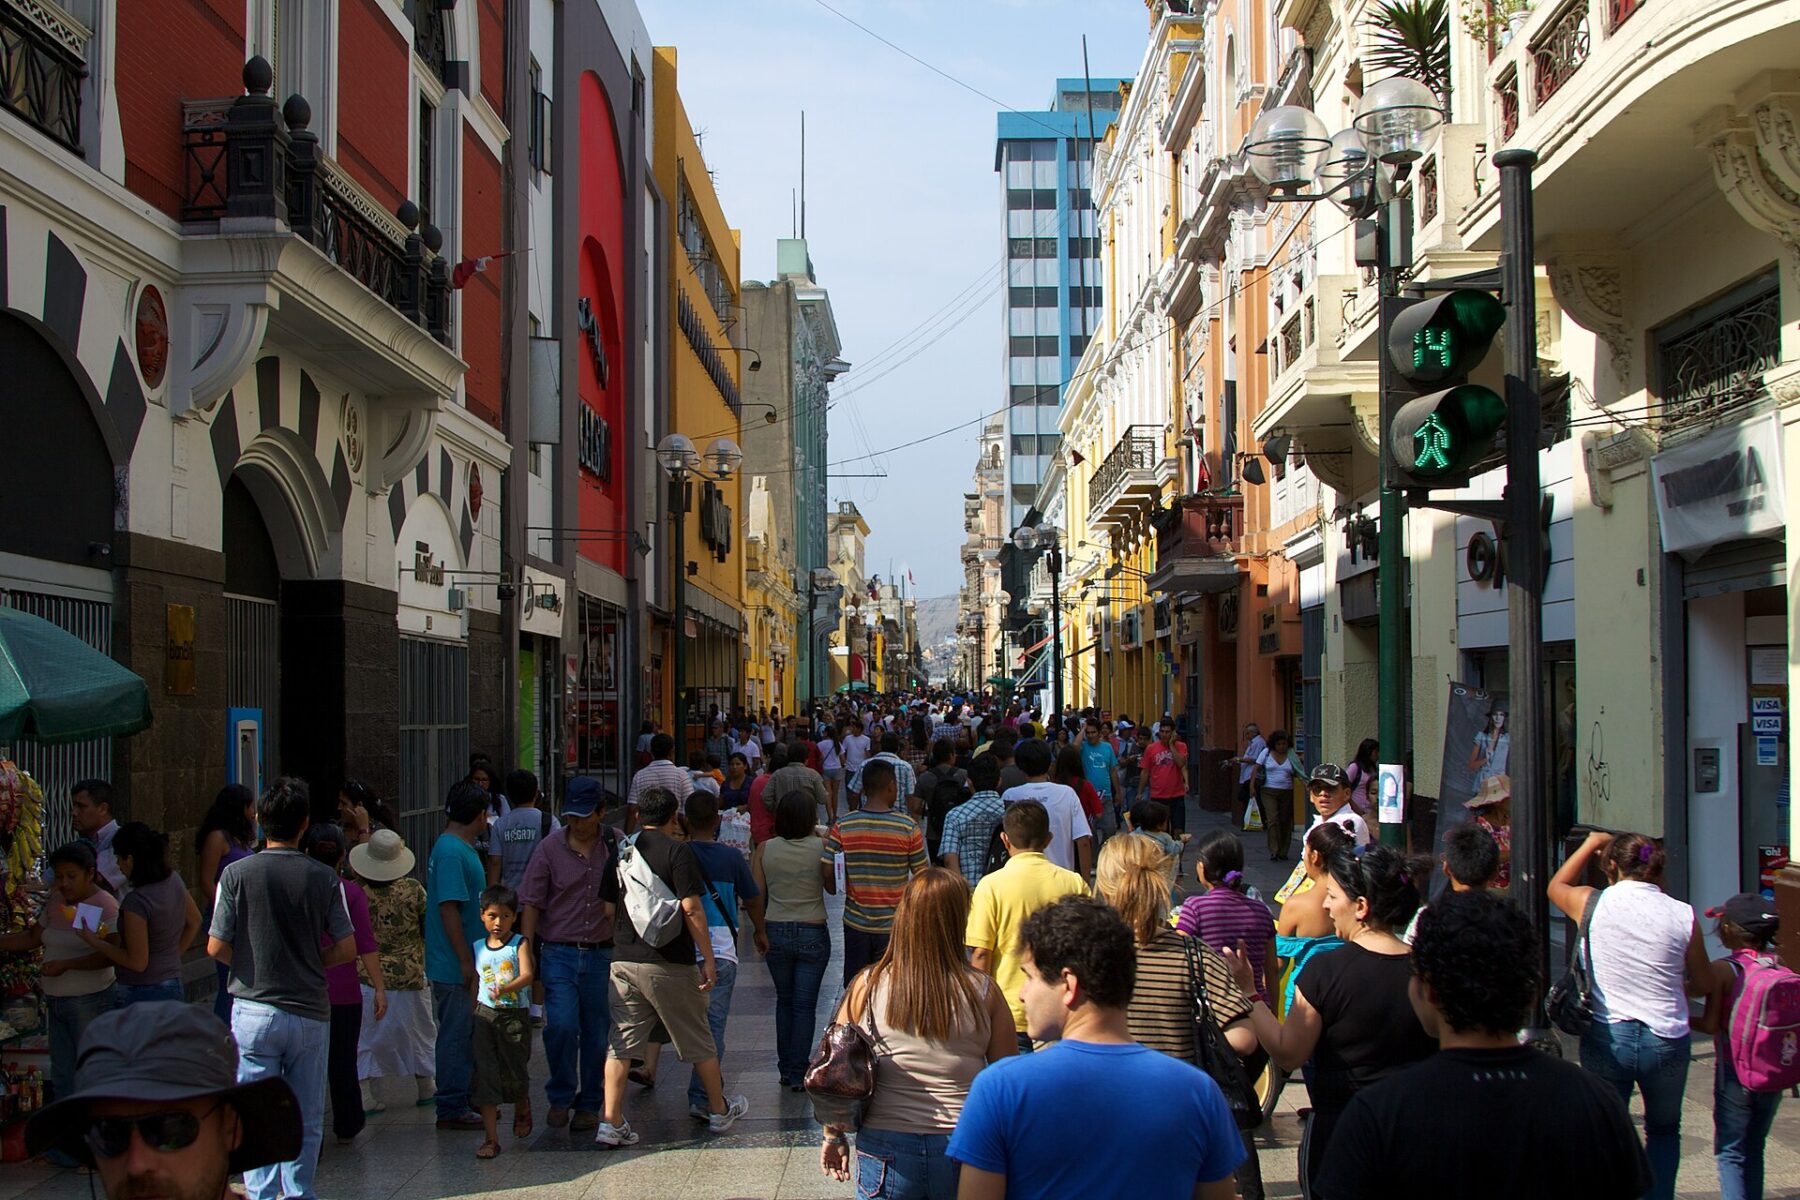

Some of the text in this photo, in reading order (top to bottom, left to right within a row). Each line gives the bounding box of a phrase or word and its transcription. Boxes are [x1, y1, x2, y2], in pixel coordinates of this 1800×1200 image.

[1413, 329, 1451, 368] 14
[1755, 700, 1780, 710] VISA
[1755, 719, 1780, 729] VISA
